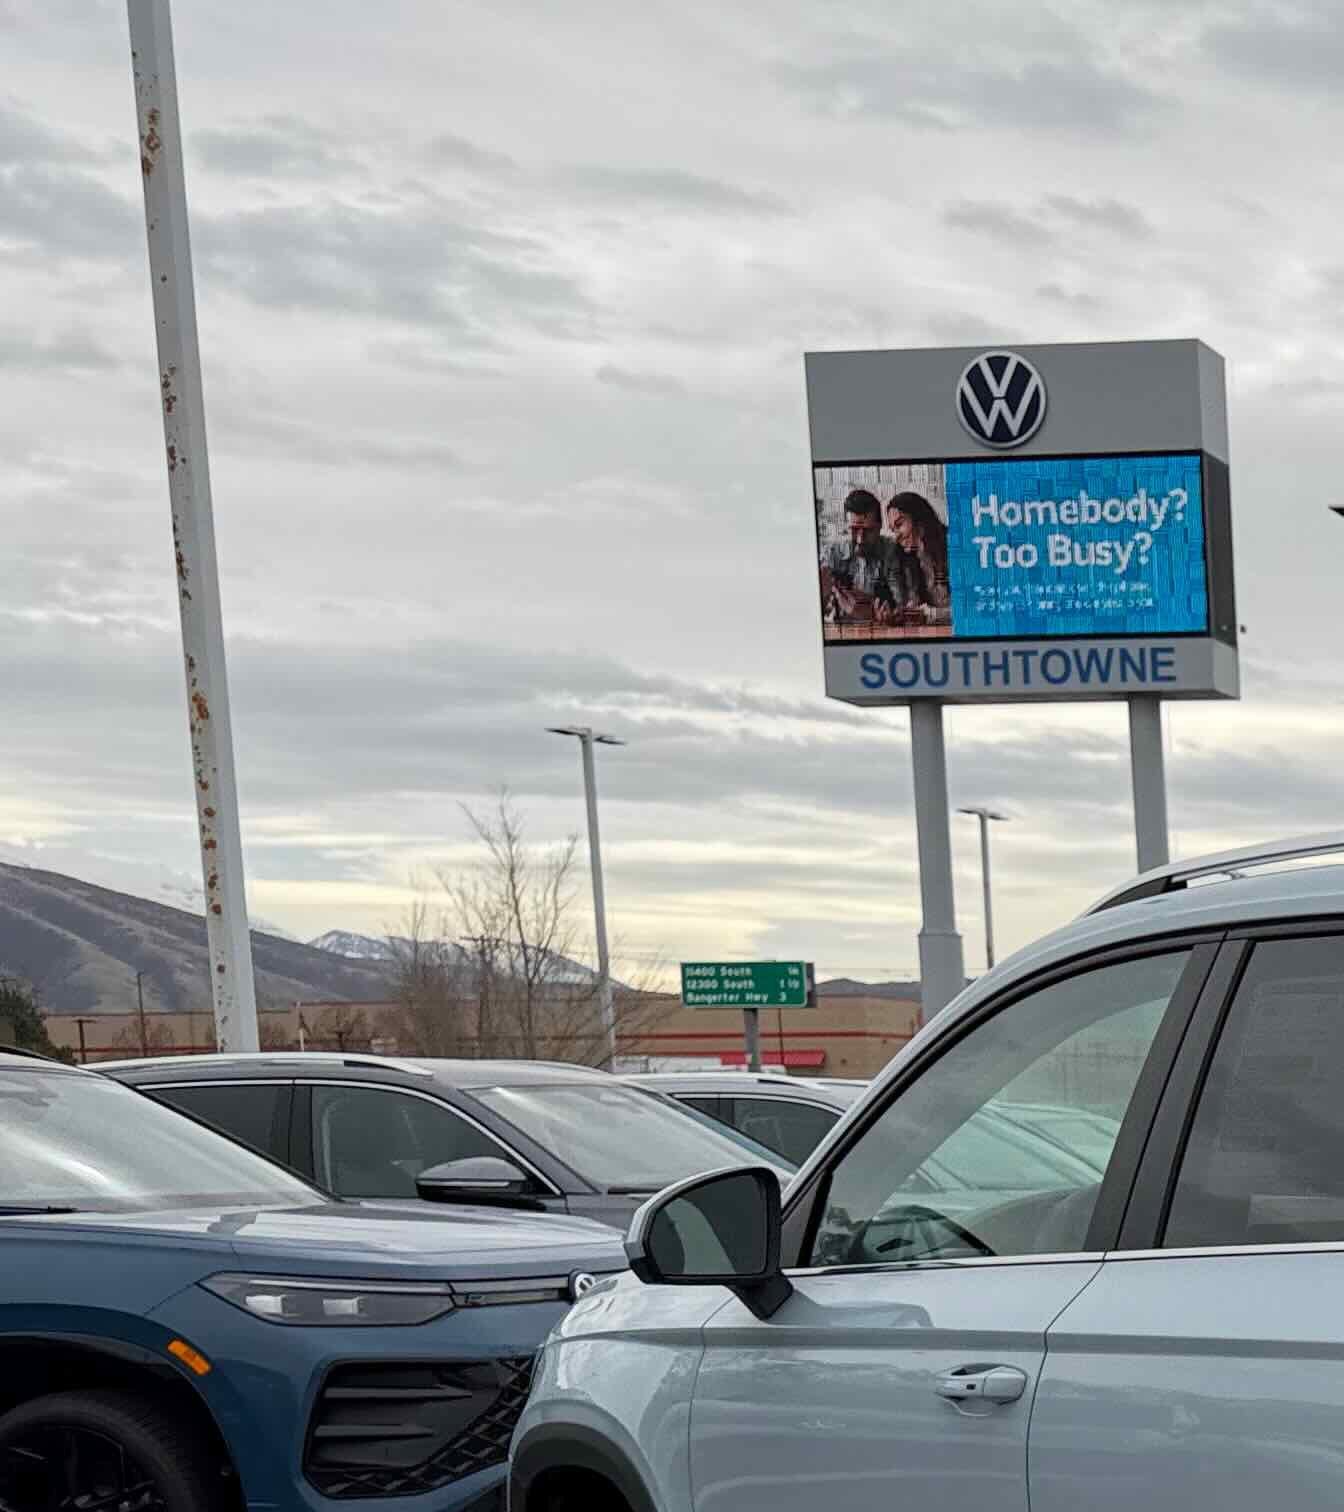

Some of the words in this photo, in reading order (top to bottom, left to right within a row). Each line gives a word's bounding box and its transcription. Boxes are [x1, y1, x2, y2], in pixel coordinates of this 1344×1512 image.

[970, 487, 1188, 531] Homebody?
[972, 535, 1038, 569] Too
[1047, 532, 1153, 575] Busy?
[859, 647, 1177, 689] SOUTHTOWNE
[686, 979, 719, 990] 12300
[723, 979, 756, 990] South
[720, 966, 752, 977] South
[686, 992, 740, 1005] Bangerter
[745, 992, 769, 1004] Hwy
